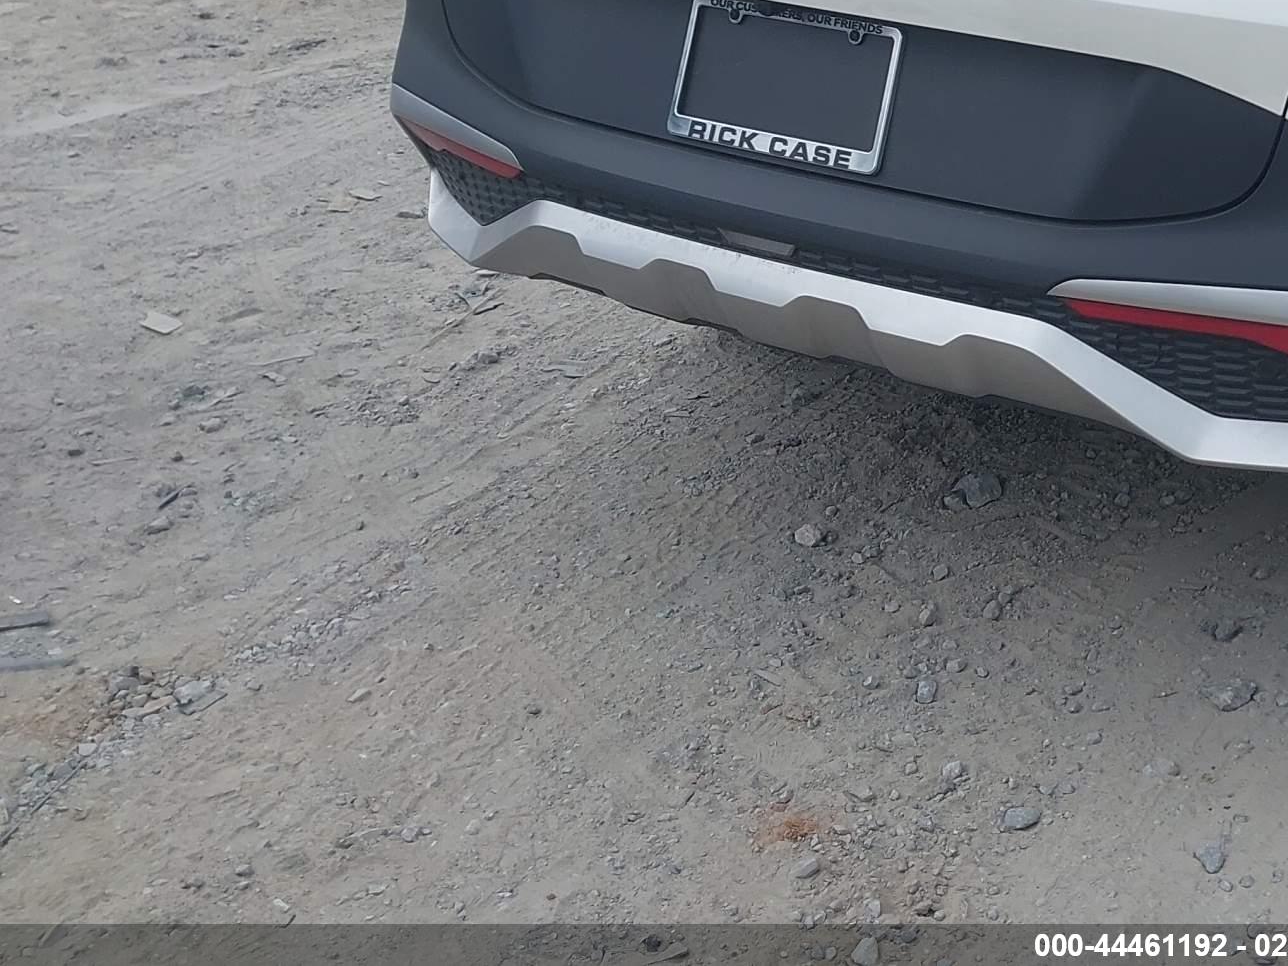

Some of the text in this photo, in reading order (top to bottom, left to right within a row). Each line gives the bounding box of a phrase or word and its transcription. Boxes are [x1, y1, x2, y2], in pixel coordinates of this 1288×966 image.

[806, 11, 832, 26] OUR
[833, 15, 884, 35] FRIENDS
[688, 120, 852, 169] RICK CASE
